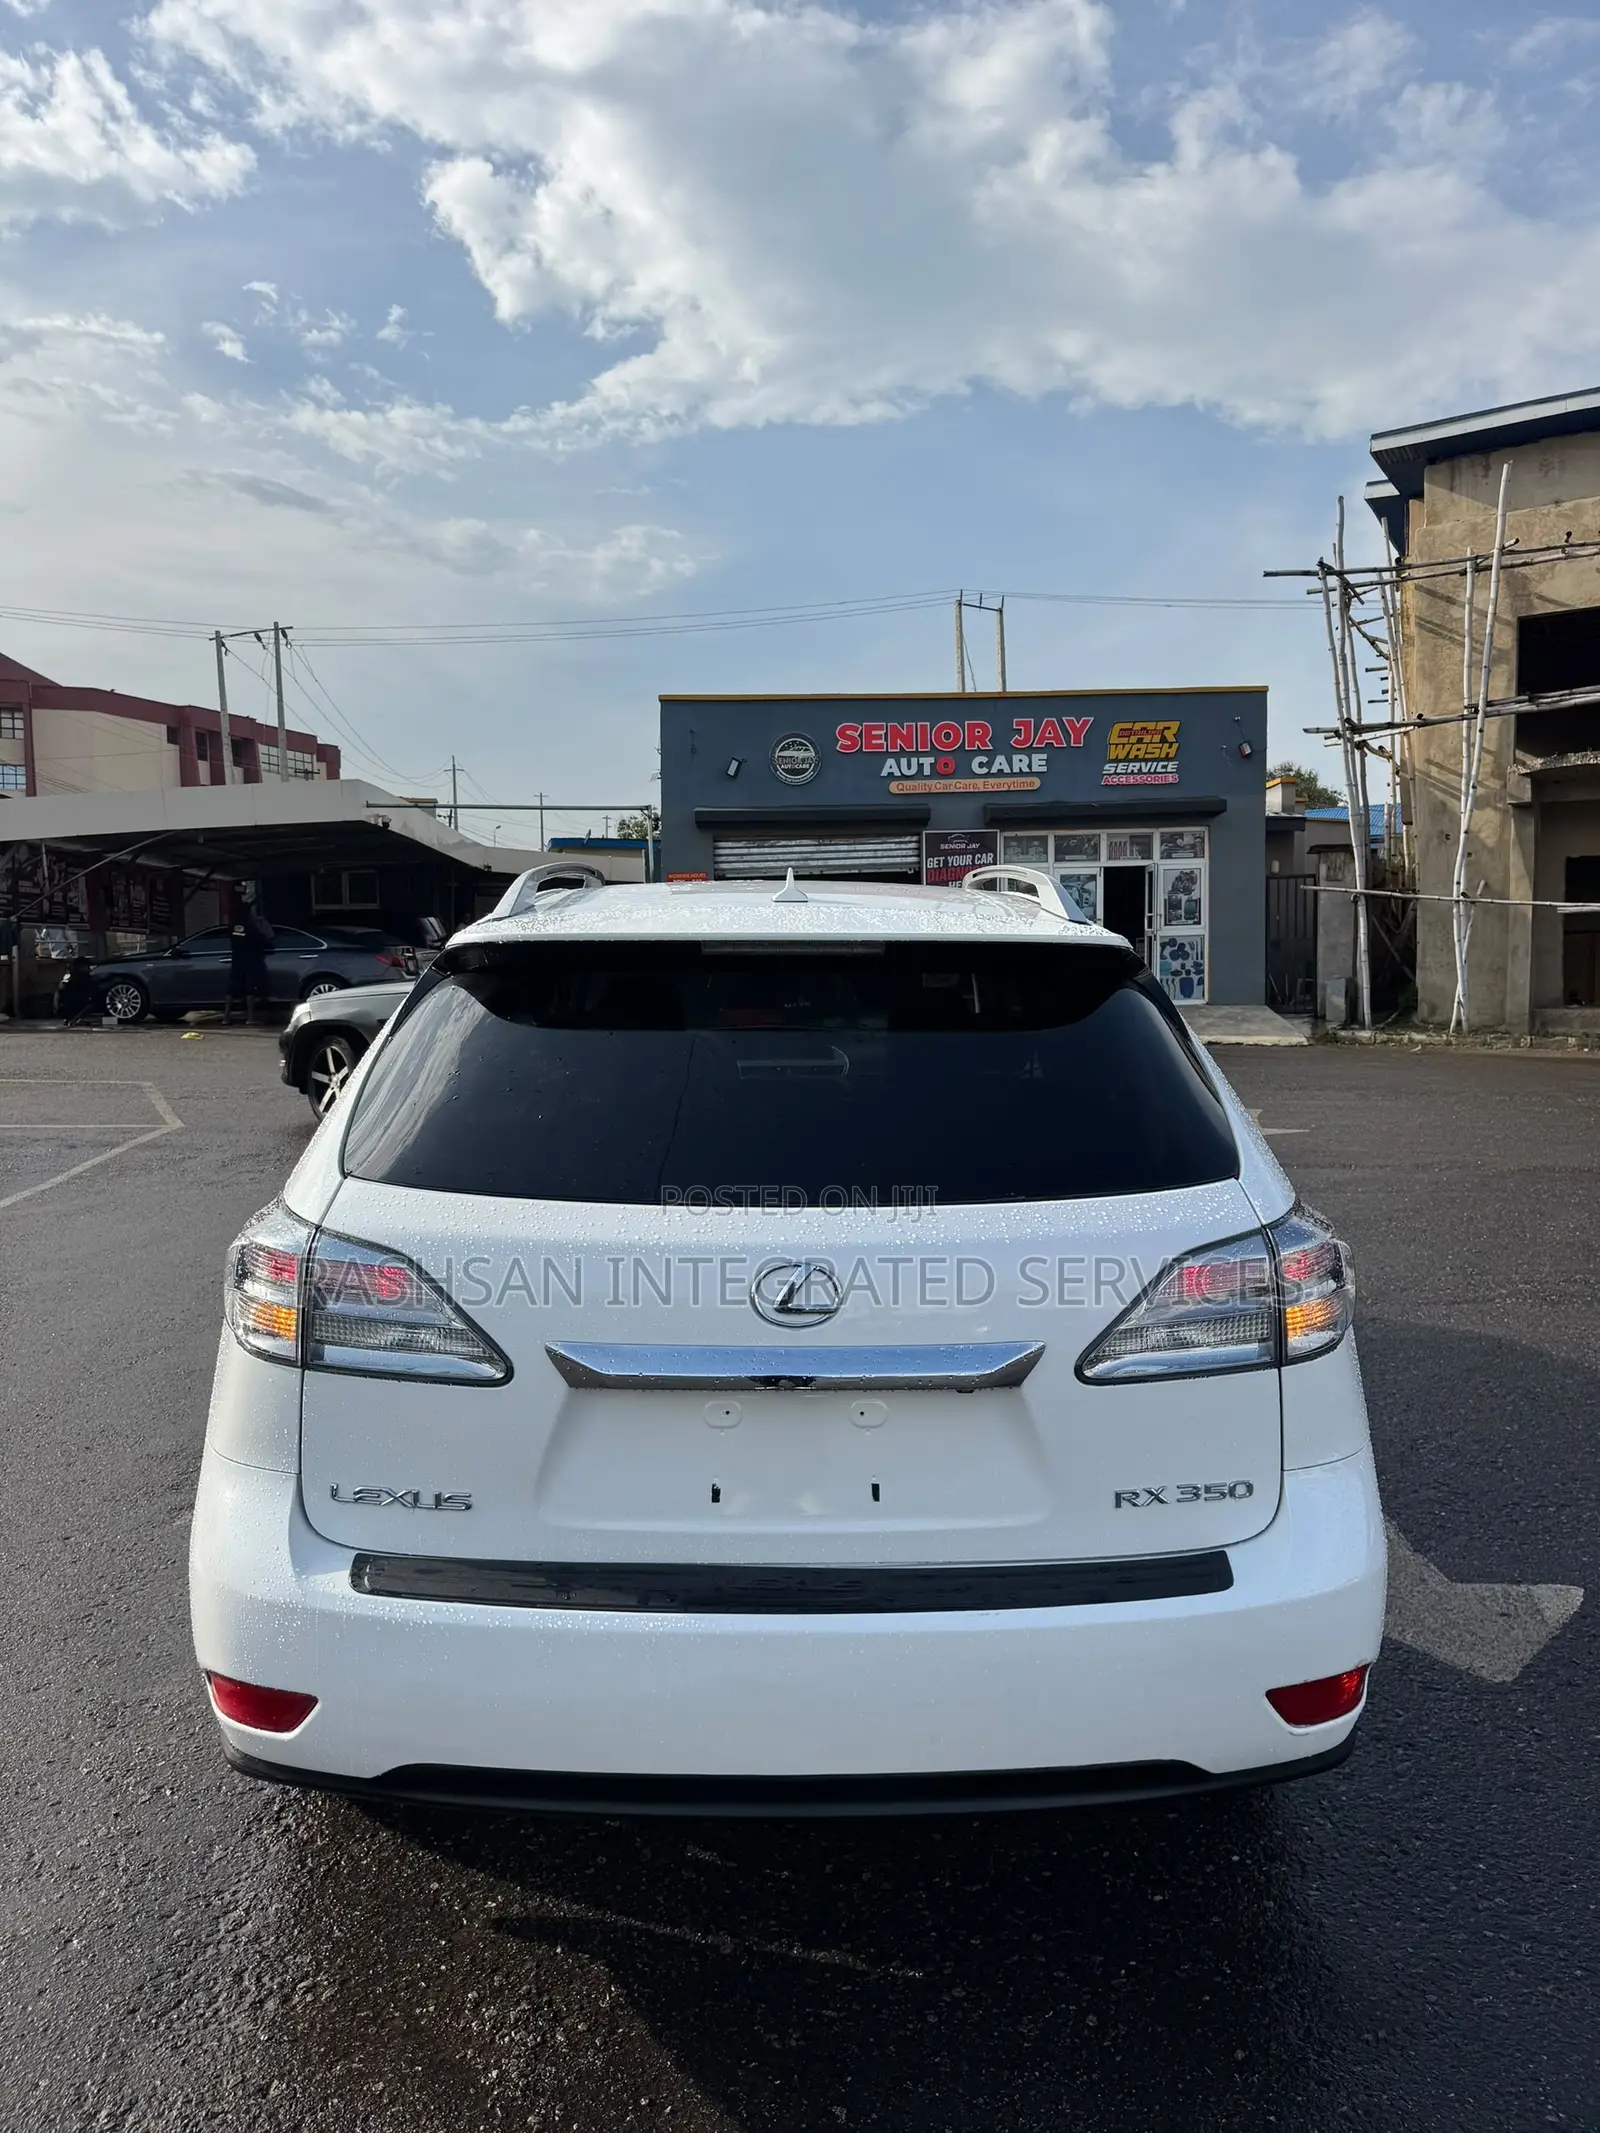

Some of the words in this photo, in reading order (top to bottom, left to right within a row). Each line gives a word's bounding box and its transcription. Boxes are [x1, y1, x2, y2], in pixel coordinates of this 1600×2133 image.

[836, 721, 994, 753] SENIOR
[1010, 716, 1095, 748] JAY
[1108, 720, 1180, 744] CAR
[1108, 743, 1180, 760] WASH
[880, 757, 956, 777] AUTO
[971, 753, 1048, 774] CARE
[1102, 761, 1179, 774] SERVICE
[896, 782, 933, 793] Quality
[934, 781, 952, 791] Car
[983, 779, 1036, 791] Everytime
[1101, 774, 1179, 785] ACCESSORIES
[927, 856, 945, 869] GET
[947, 854, 973, 867] YOUR
[974, 852, 994, 865] CAR
[330, 1482, 472, 1510] LEXUS
[1114, 1486, 1171, 1508] RX
[1176, 1480, 1254, 1502] 350
